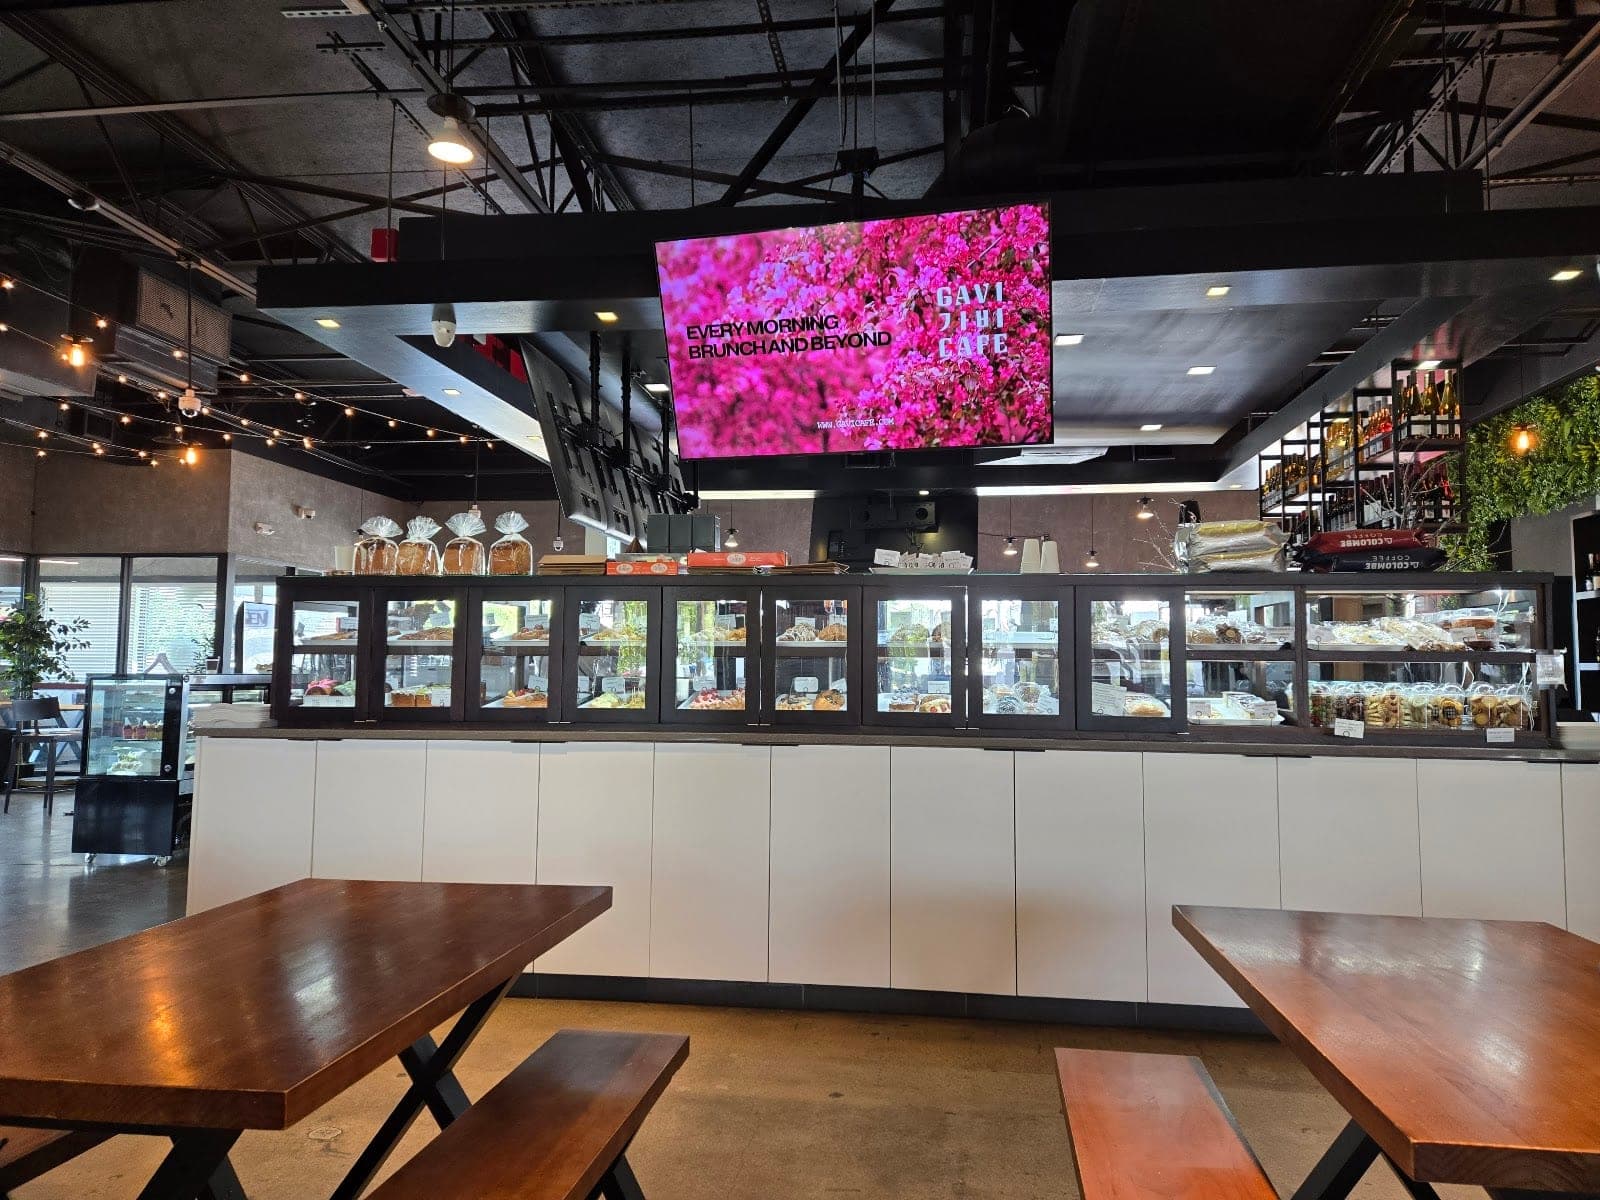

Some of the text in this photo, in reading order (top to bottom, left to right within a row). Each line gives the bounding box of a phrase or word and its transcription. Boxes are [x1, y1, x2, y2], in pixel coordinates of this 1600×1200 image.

[936, 281, 1003, 307] GAVI
[686, 314, 839, 340] EVERY MORNING
[689, 331, 892, 360] BRUNCH AND BEYOND
[938, 333, 1008, 359] CAFE
[1340, 538, 1384, 547] COLOMBE
[1365, 561, 1409, 570] COLOMBE
